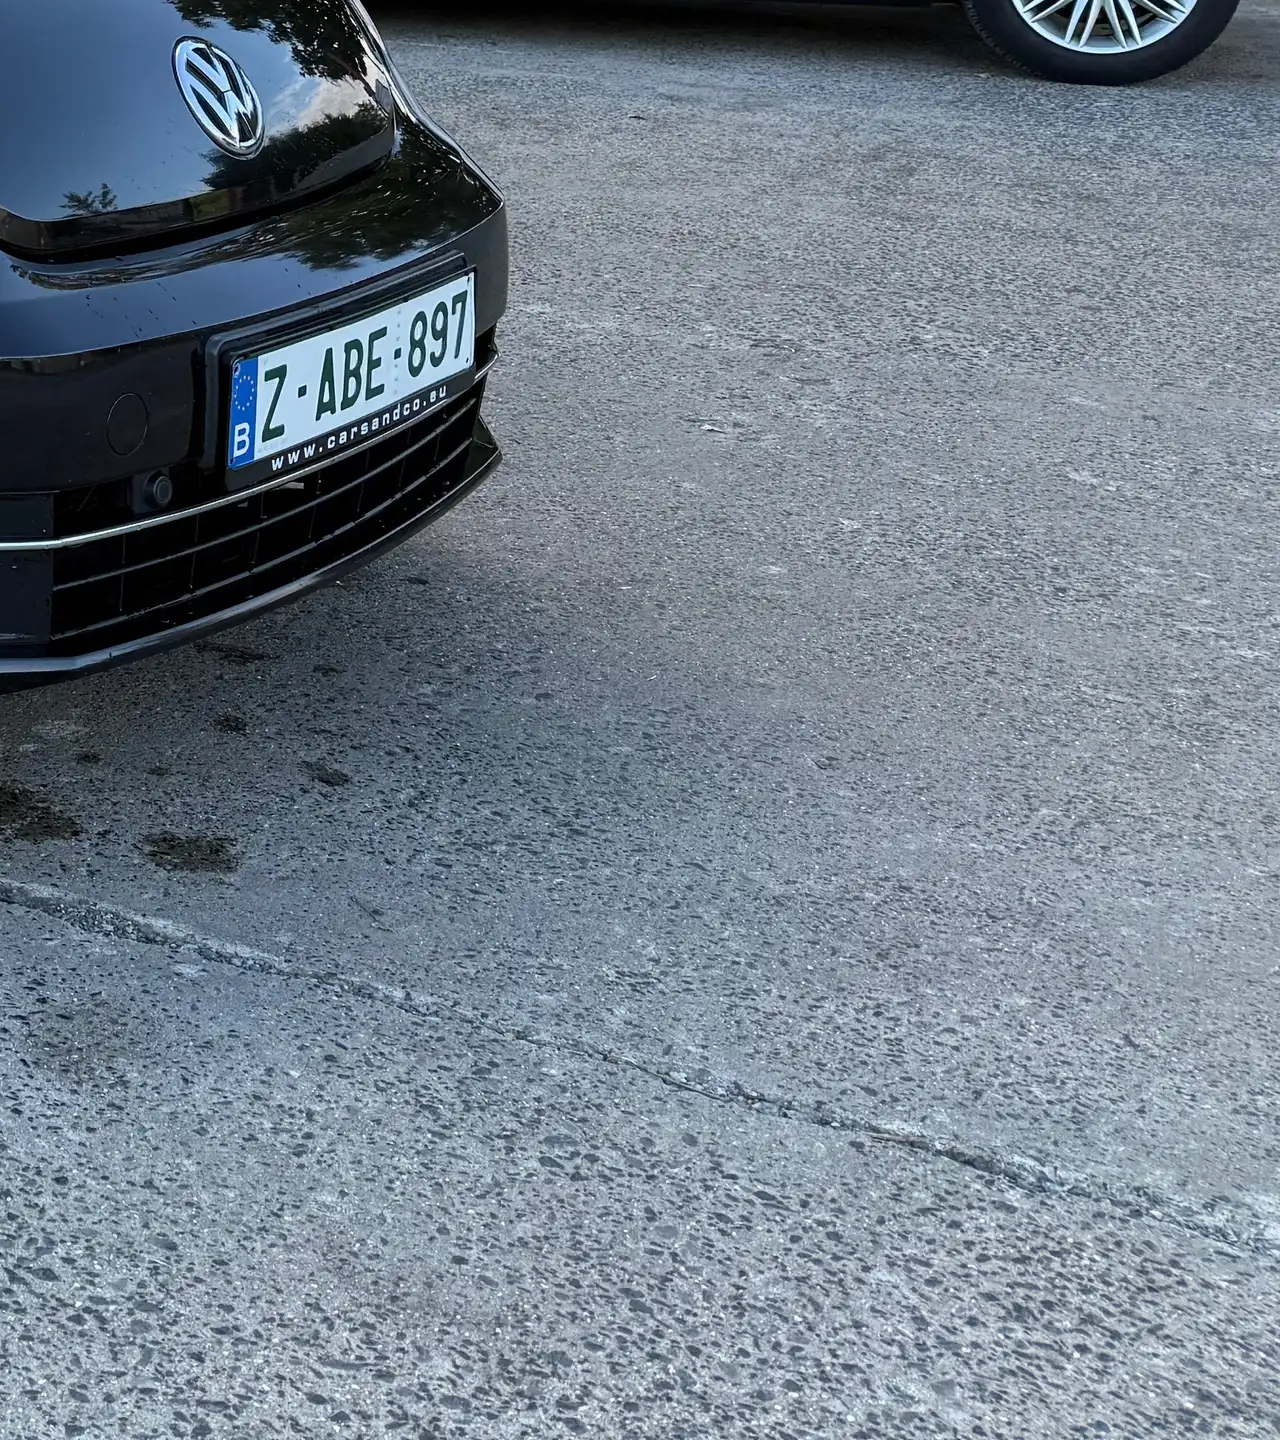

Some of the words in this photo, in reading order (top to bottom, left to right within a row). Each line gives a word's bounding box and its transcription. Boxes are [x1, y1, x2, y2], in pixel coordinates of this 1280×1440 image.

[262, 290, 468, 443] Z-ABE-897
[233, 422, 251, 457] B
[271, 385, 447, 471] www.carsandco.eu
